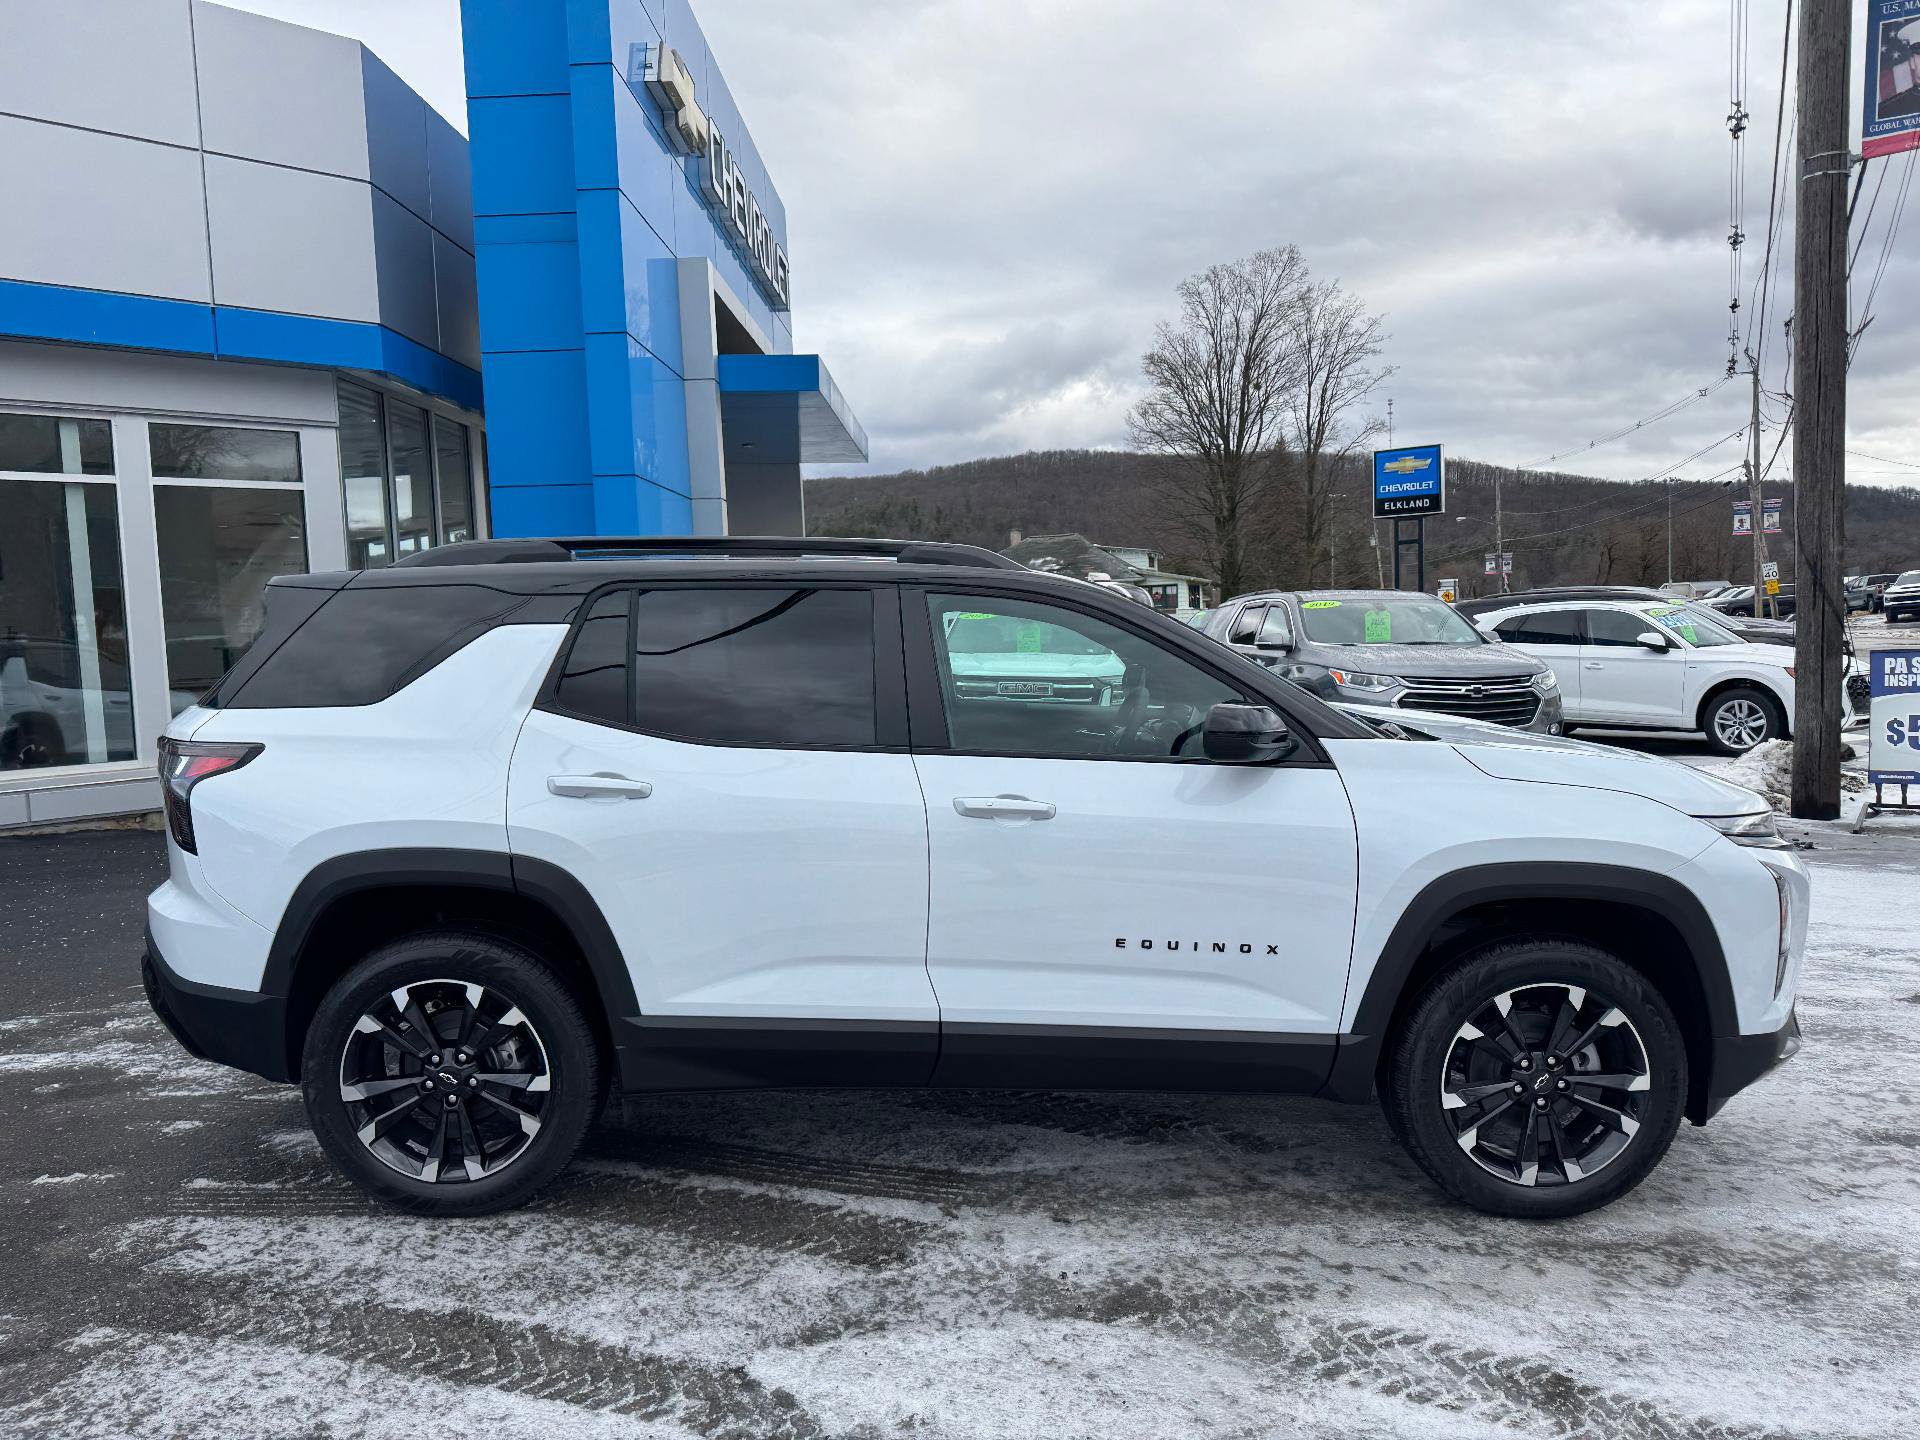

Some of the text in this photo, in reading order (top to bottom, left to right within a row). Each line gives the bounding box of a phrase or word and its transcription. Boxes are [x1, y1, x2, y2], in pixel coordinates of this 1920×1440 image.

[1883, 4, 1901, 14] U.S.
[1869, 120, 1902, 133] GLOBAL
[707, 117, 790, 311] CHEVROLET
[1380, 481, 1434, 493] CHEVROLET
[1384, 499, 1430, 510] ELKLAND
[1884, 657, 1908, 673] PA
[1000, 683, 1050, 693] GMC
[1115, 938, 1279, 955] EQUINOX
